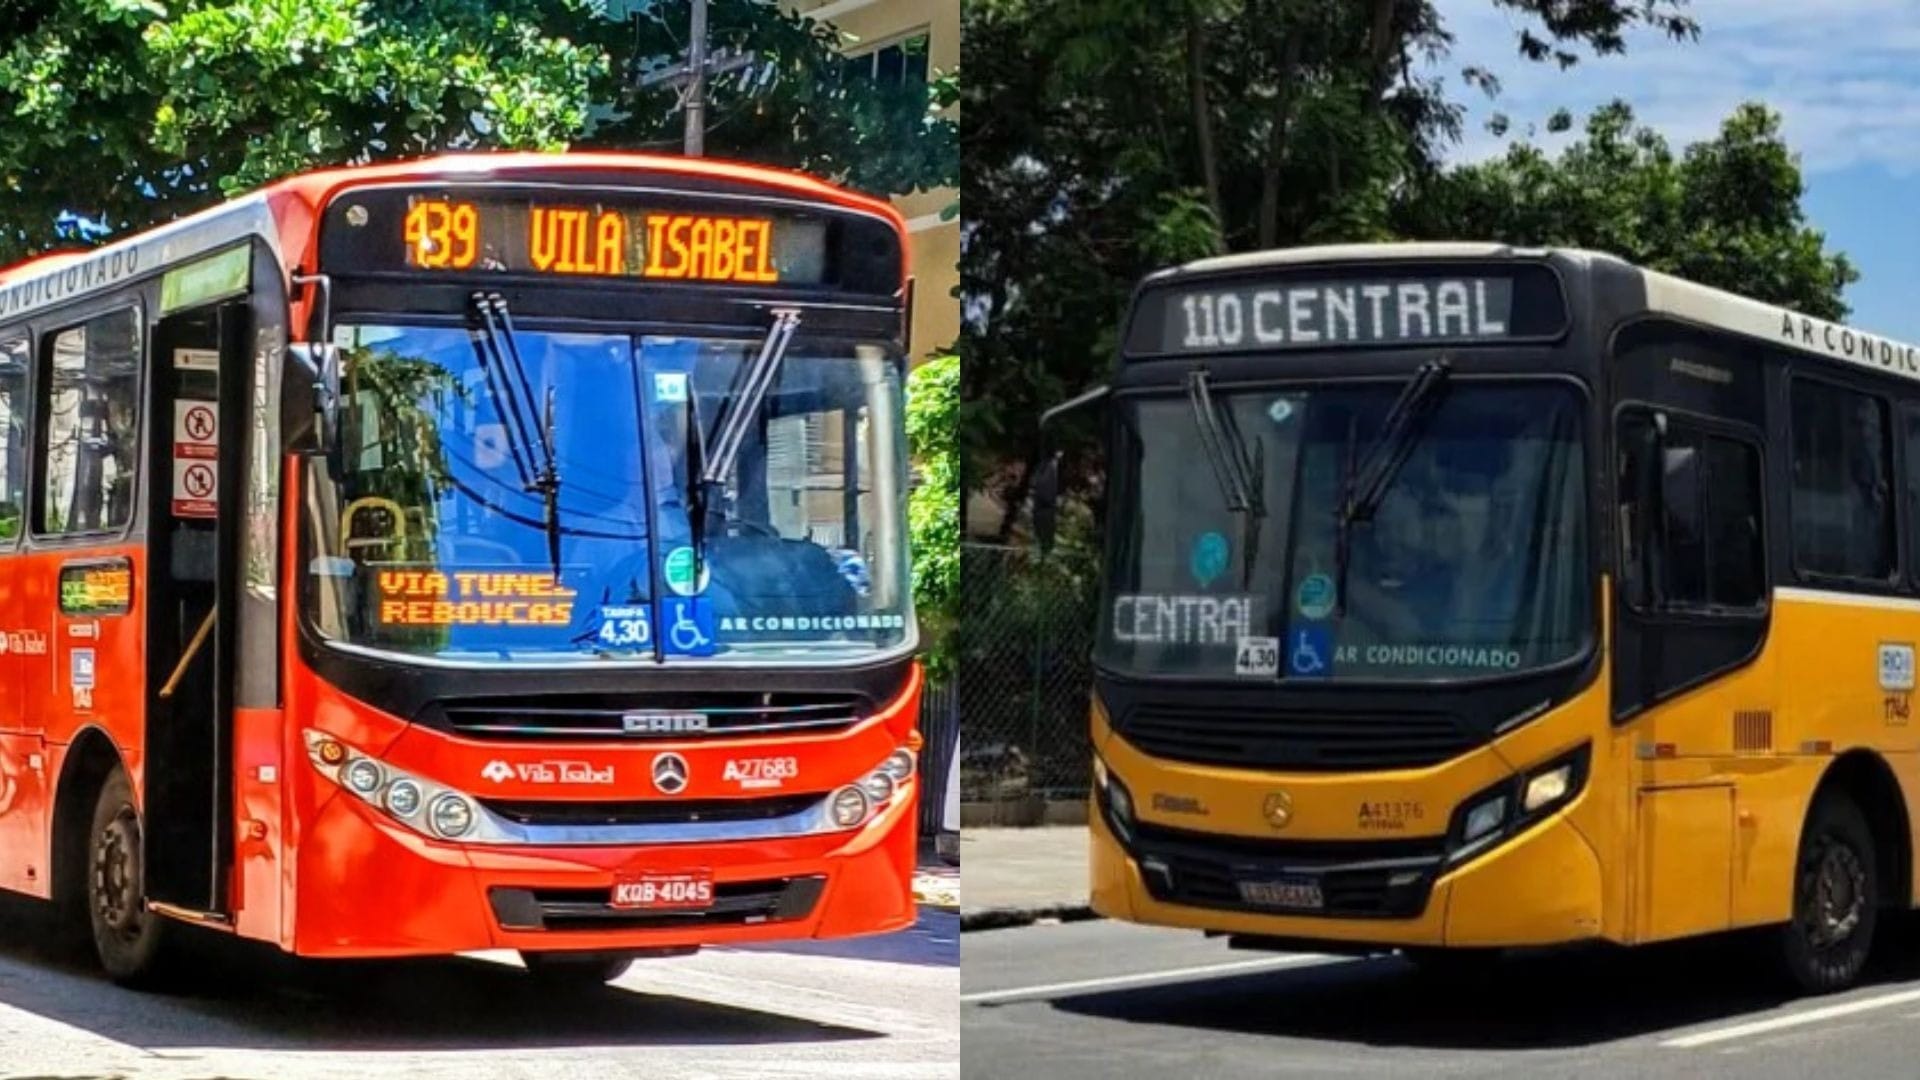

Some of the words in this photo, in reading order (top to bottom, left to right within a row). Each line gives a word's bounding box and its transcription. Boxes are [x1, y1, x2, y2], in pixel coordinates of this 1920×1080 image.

[405, 202, 478, 268] 439
[530, 208, 624, 275] VILA
[645, 214, 778, 282] ISABEL
[1183, 294, 1243, 346] 110
[1252, 280, 1505, 343] CENTRAL
[1782, 314, 1814, 345] AR
[380, 571, 447, 595] VIA
[381, 602, 574, 624] REBOUCAS
[719, 617, 749, 631] AR
[752, 615, 904, 631] CONDICIONADO
[600, 619, 649, 646] 4,30
[1239, 648, 1275, 669] 4,30
[1333, 646, 1357, 663] AR
[1366, 646, 1521, 668] CONDICIONADO
[623, 715, 708, 733] CAIO
[516, 762, 556, 783] Vila
[544, 759, 615, 784] Isabel
[722, 757, 798, 781] A27683
